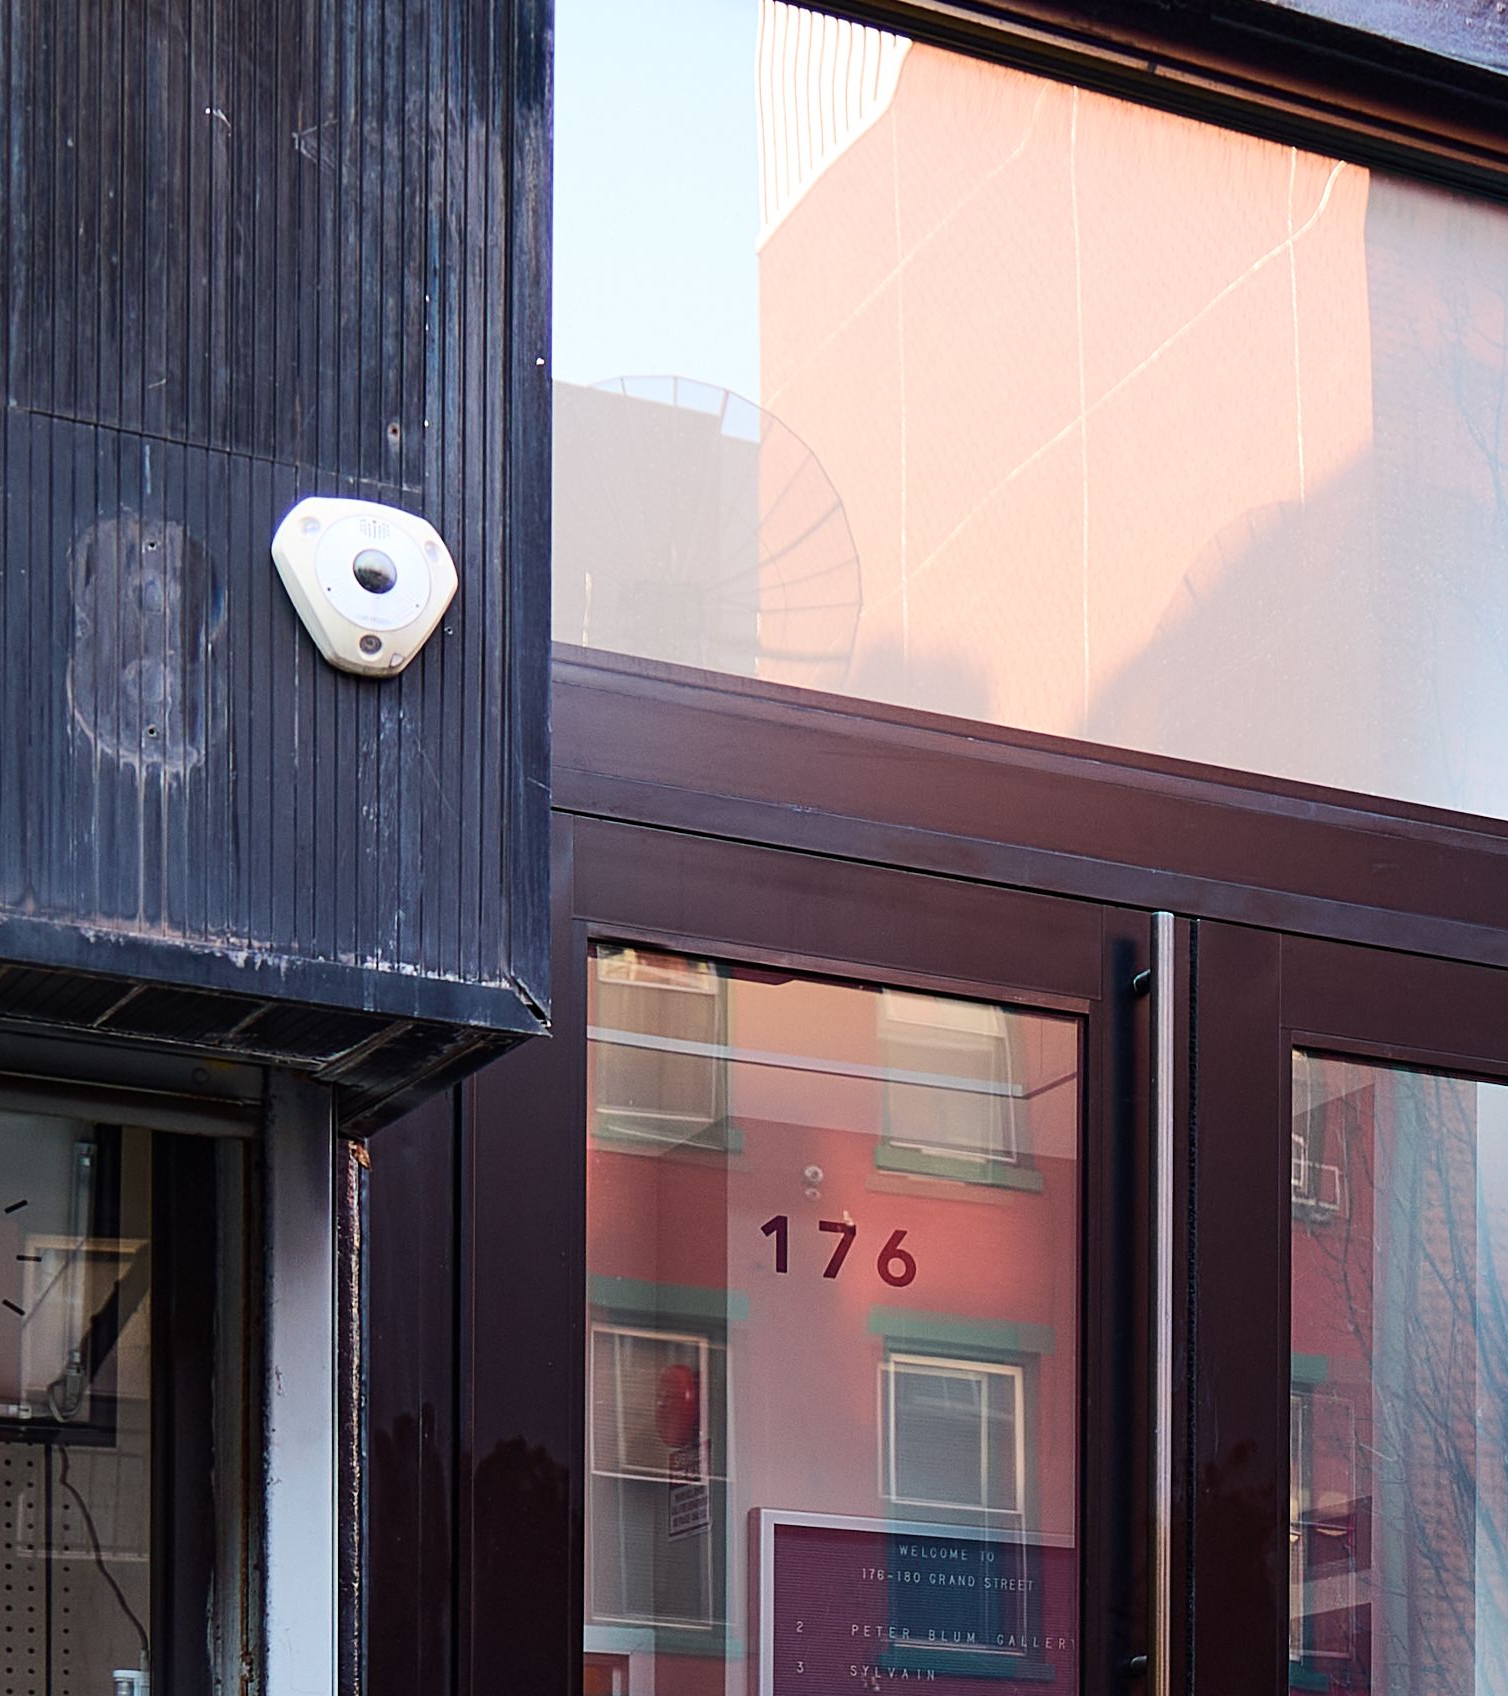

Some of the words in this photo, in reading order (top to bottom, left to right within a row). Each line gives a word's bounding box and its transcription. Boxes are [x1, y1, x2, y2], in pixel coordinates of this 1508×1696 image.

[760, 1215, 917, 1289] 176
[900, 1545, 968, 1562] WELCOME
[862, 1568, 921, 1584] 176-180
[930, 1573, 976, 1588] GRAND
[984, 1577, 1034, 1592] STREET
[796, 1621, 804, 1633] 2
[852, 1624, 911, 1640] PETER
[928, 1628, 976, 1644] BLUM
[796, 1662, 804, 1673] 3
[850, 1665, 936, 1681] SYLVAIN
